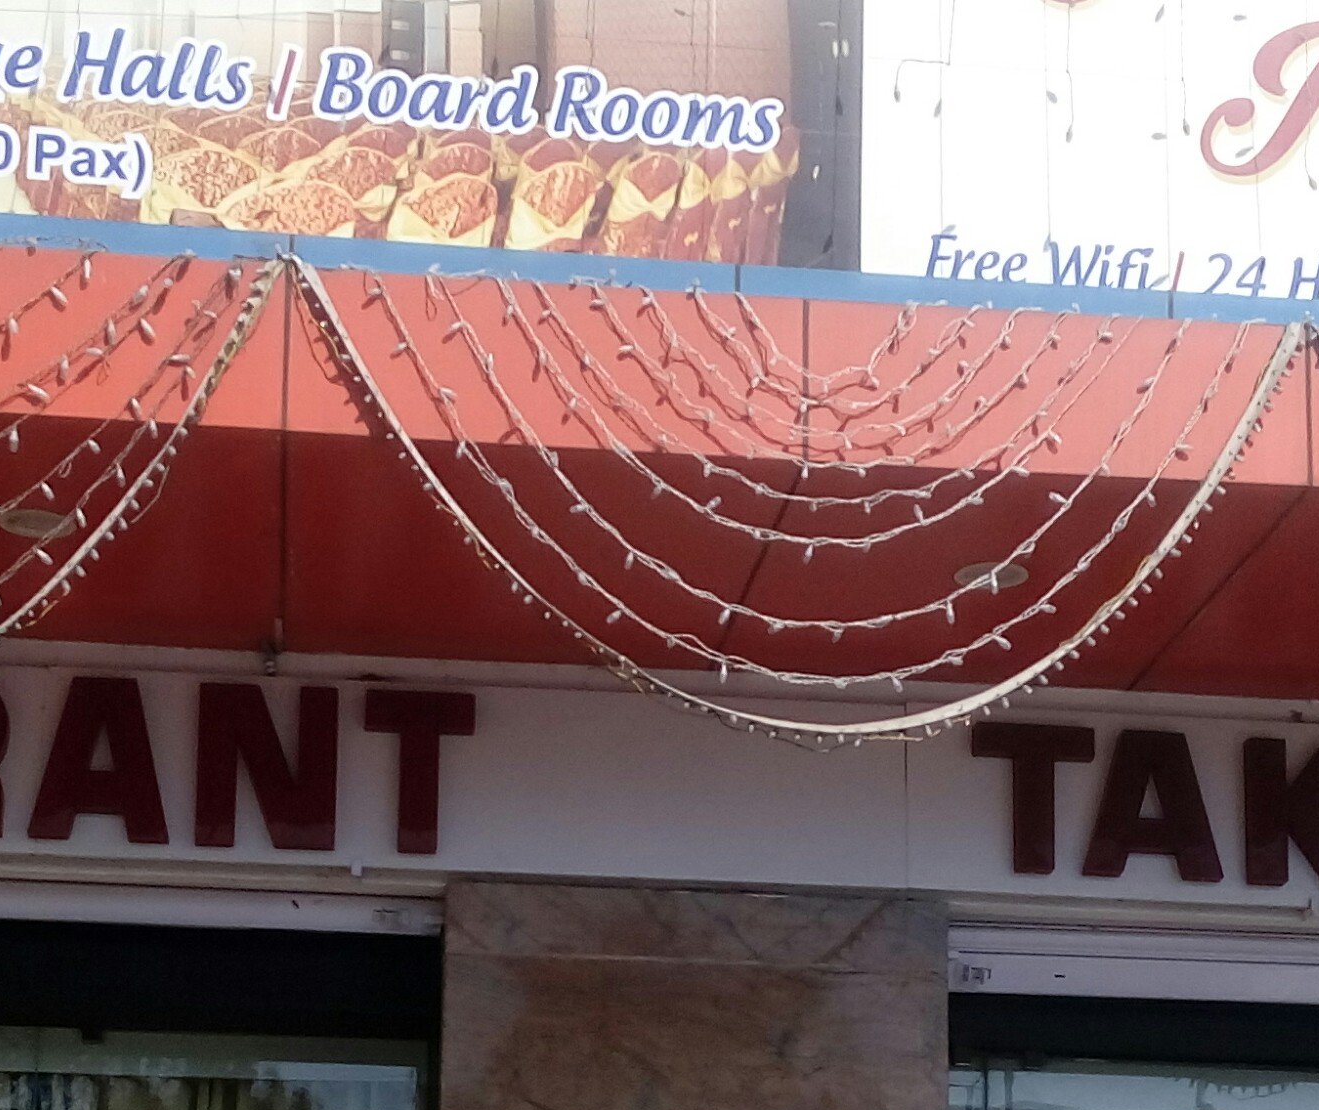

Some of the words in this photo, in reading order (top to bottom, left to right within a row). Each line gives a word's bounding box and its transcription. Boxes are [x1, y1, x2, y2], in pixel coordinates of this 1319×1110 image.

[62, 28, 250, 108] Halls
[318, 51, 536, 130] Board
[553, 71, 779, 148] Rooms
[34, 133, 147, 193] Pax)
[925, 233, 1028, 284] Free
[1046, 240, 1154, 290] Wifi
[1207, 252, 1267, 298] 24
